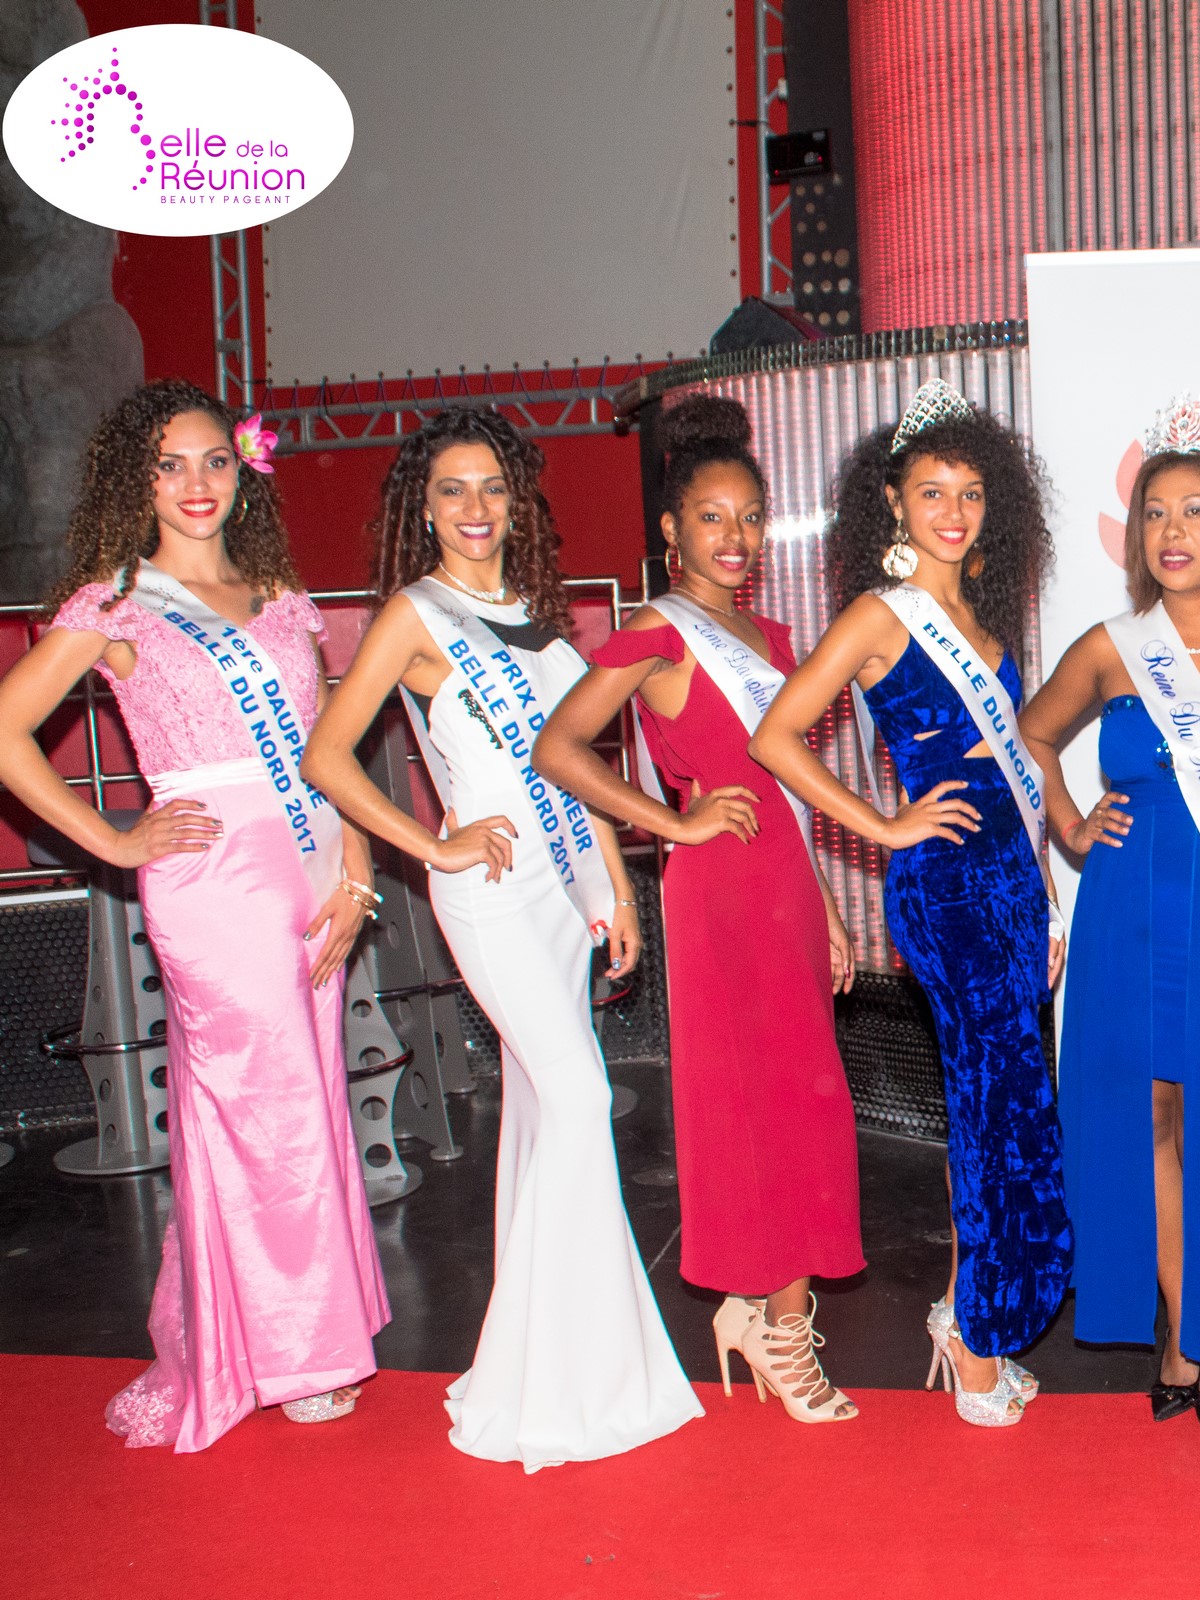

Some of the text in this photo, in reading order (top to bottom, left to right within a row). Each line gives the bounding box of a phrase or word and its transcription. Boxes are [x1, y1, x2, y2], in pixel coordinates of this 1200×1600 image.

[163, 611, 316, 853] BELLE DU NORD 2017
[449, 639, 575, 886] BELLE DU NORD 2017
[491, 649, 537, 709] PRIX
[922, 622, 1040, 810] BELLE DU NORD
[1140, 639, 1177, 699] Reine
